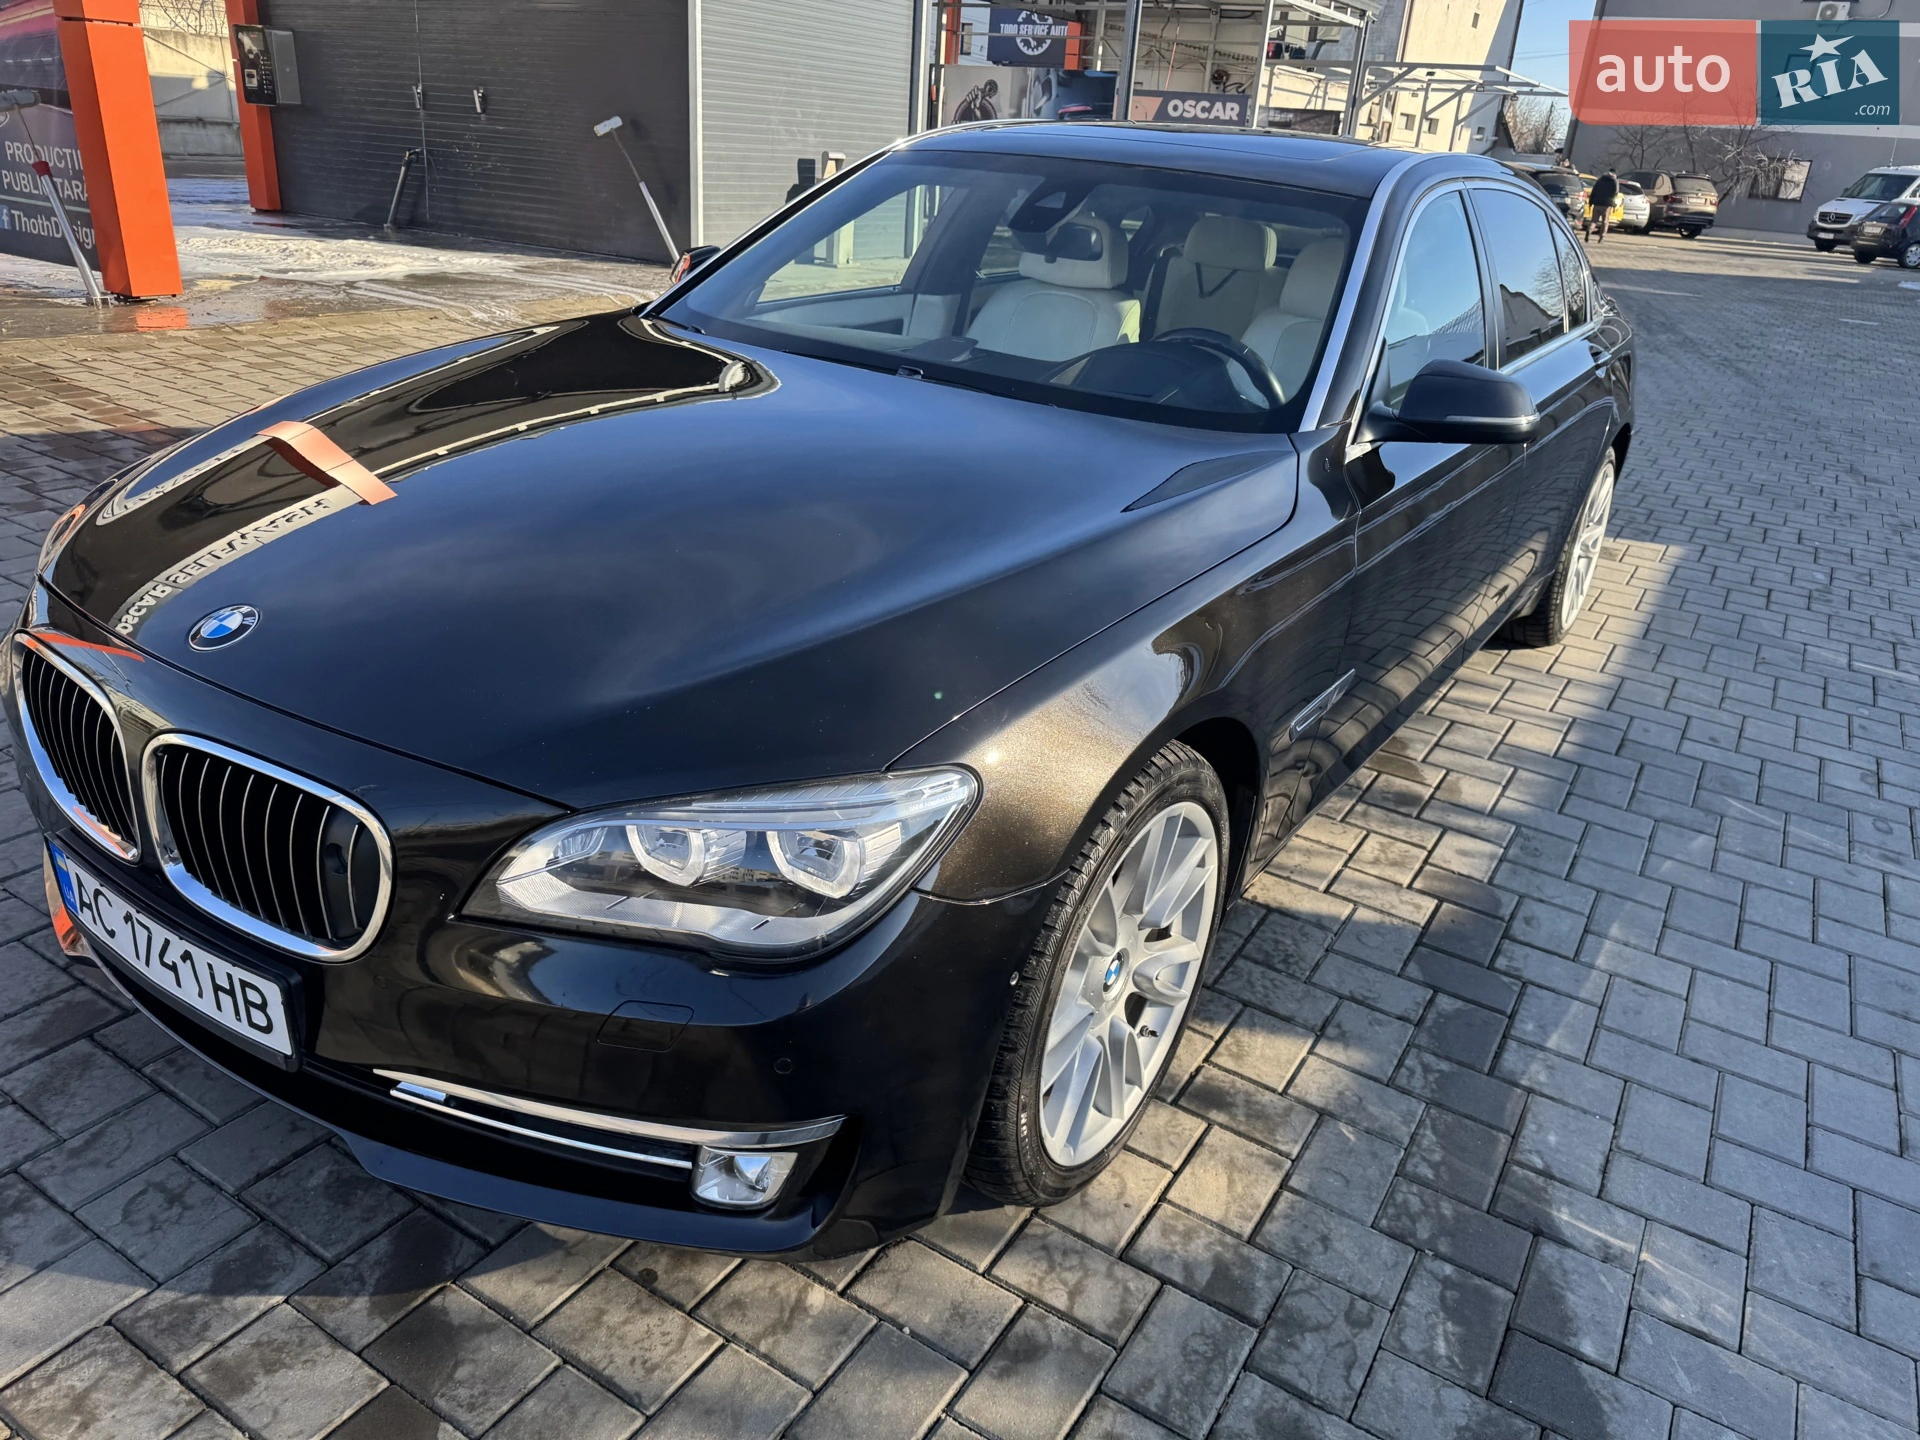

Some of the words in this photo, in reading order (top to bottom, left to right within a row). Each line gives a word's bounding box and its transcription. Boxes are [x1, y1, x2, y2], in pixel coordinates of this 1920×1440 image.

[1019, 23, 1049, 36] SERVICE
[1167, 99, 1240, 121] OSCAR
[2, 169, 89, 202] PUBLITAR
[11, 209, 96, 250] ThothDig
[63, 883, 76, 906] UA
[75, 871, 116, 940] AC
[122, 909, 204, 1000] 1741
[206, 960, 274, 1036] HB
